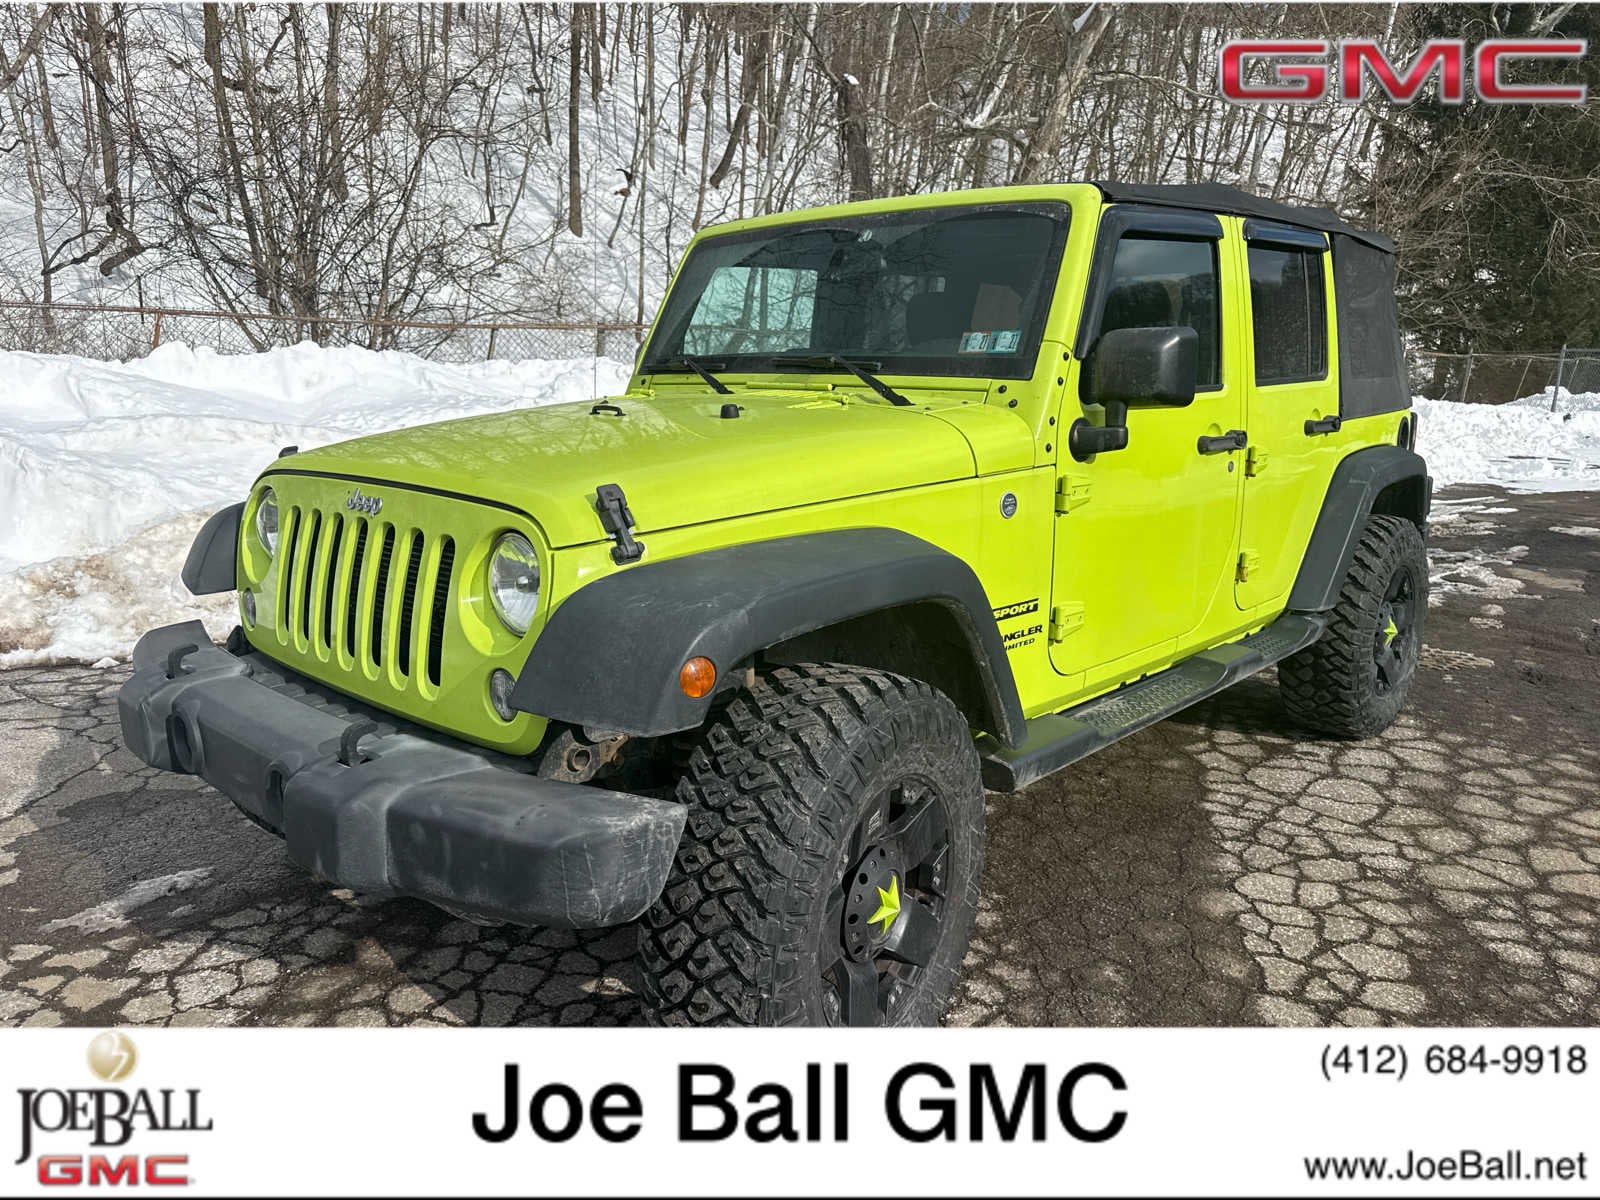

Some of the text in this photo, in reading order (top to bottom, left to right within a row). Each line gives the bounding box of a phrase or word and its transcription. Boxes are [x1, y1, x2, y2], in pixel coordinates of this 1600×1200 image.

[347, 488, 383, 517] Jeep
[993, 600, 1037, 619] SPORT
[1003, 624, 1042, 642] NGLER
[1005, 638, 1035, 650] IMITED
